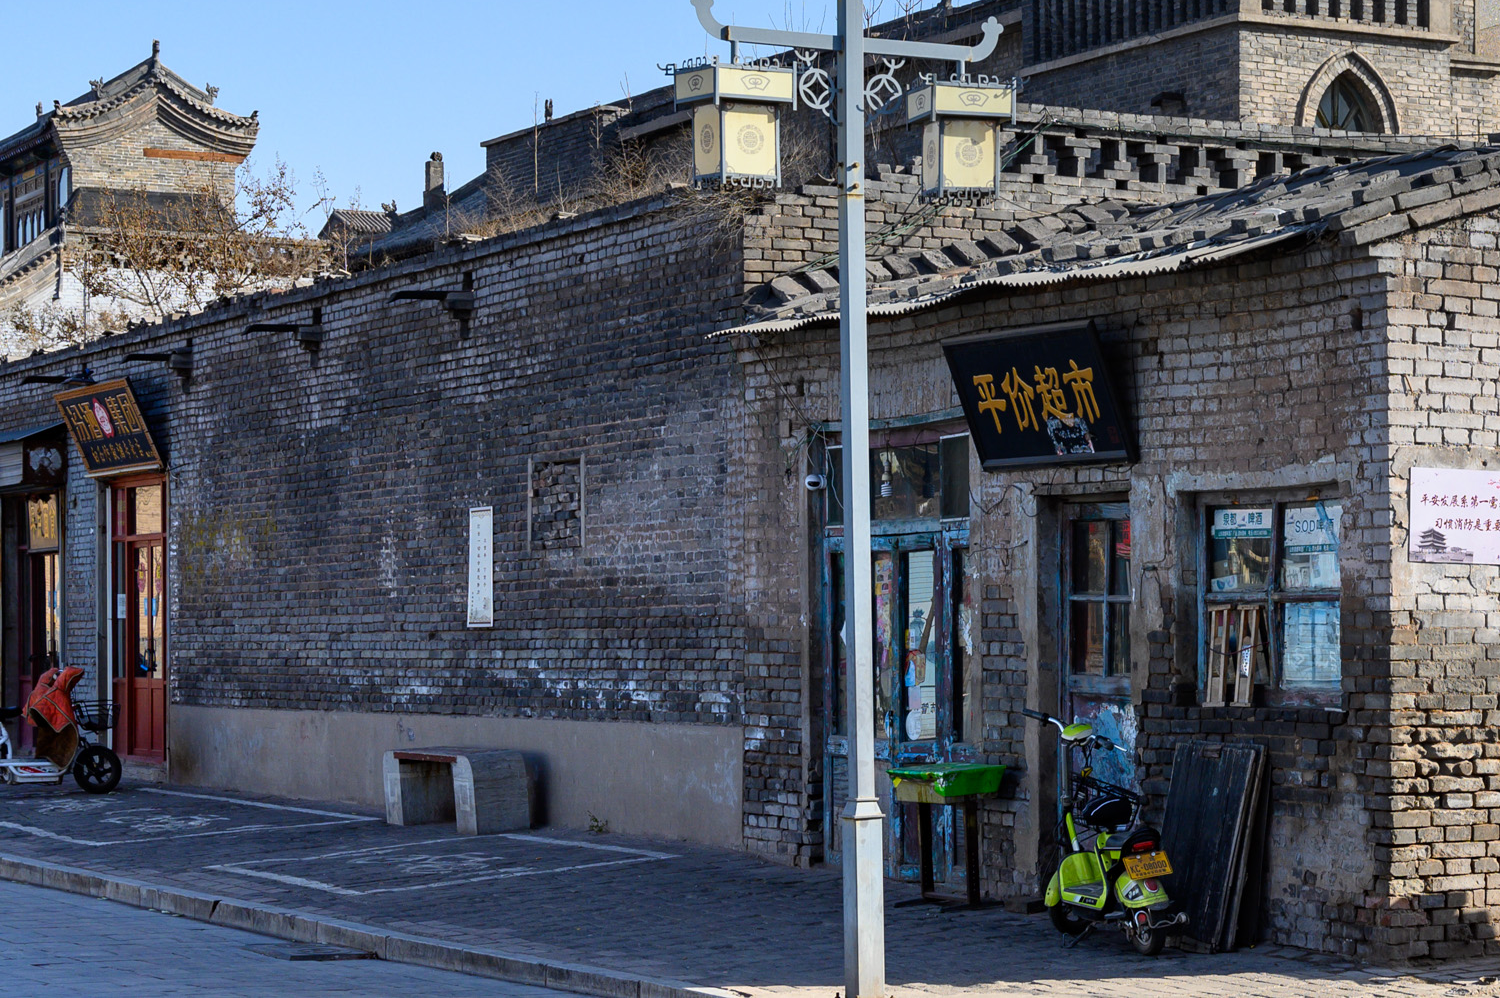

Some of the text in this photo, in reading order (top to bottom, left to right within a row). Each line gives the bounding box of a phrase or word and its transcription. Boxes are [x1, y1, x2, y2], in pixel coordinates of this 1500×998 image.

[105, 393, 141, 435] 集团
[973, 359, 1100, 434] 平价超市
[1248, 512, 1263, 525] 啤酒
